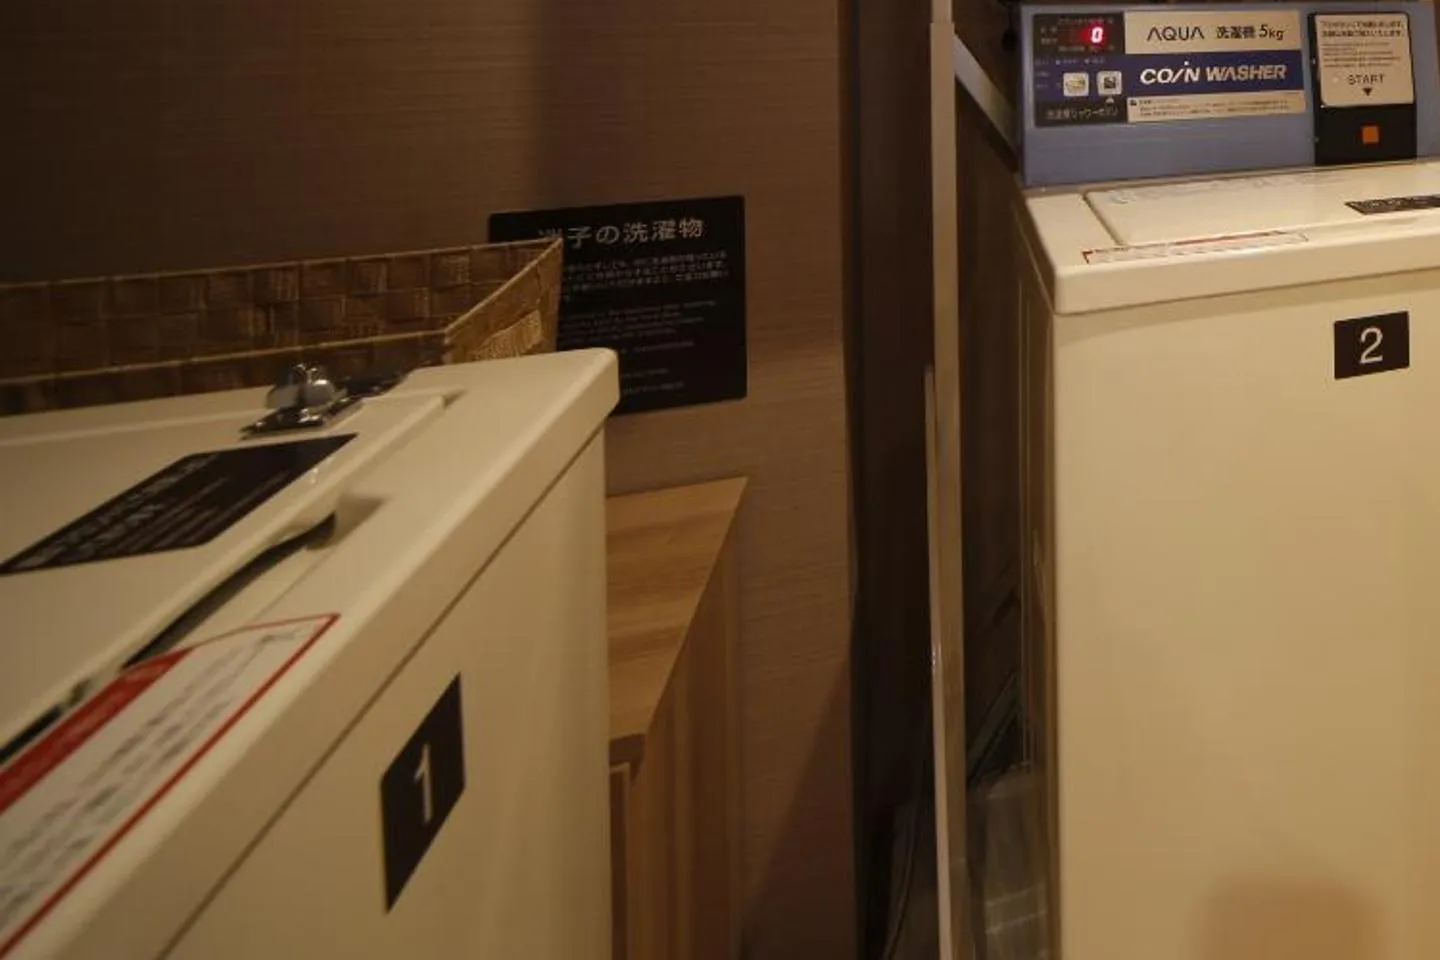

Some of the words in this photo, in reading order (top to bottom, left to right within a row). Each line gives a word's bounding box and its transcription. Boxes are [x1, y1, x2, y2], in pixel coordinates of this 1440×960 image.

[1092, 27, 1104, 44] 0
[1147, 26, 1205, 41] AQUA
[1260, 24, 1284, 41] 5kg
[1206, 64, 1288, 82] WASHER
[1348, 73, 1384, 86] START
[538, 217, 704, 249] 子の洗濯物
[1359, 327, 1383, 364] 2
[413, 742, 432, 825] 1
